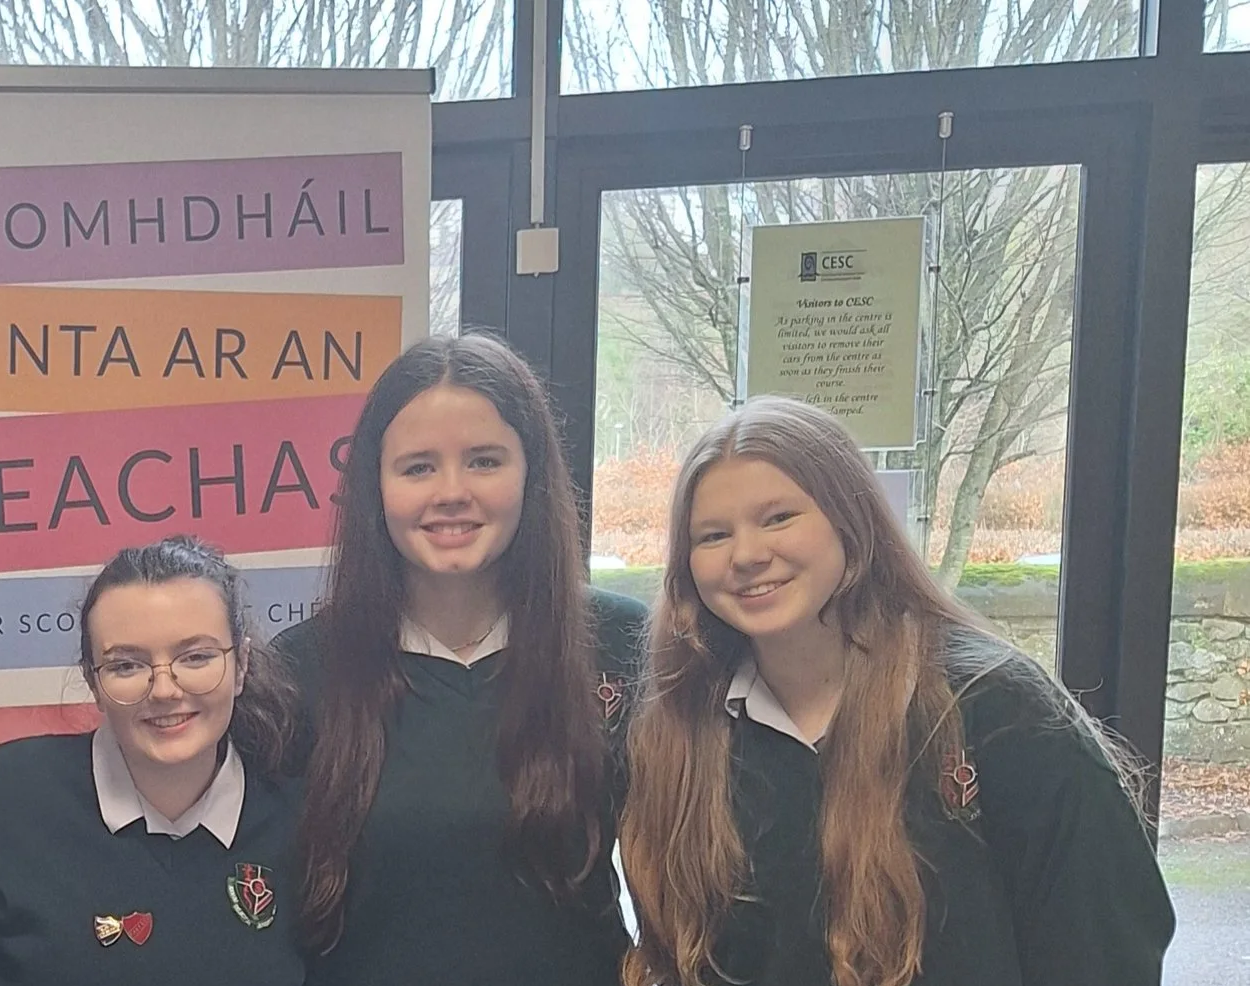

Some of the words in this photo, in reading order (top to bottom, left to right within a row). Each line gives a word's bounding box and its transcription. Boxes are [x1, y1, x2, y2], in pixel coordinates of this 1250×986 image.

[822, 255, 853, 269] CESC
[796, 299, 831, 309] Visitors
[834, 299, 844, 307] to
[845, 296, 874, 307] CESC
[774, 316, 788, 327] As
[789, 315, 825, 328] parking
[838, 312, 853, 323] the
[854, 313, 883, 322] centre
[884, 311, 892, 321] is
[830, 325, 857, 336] would
[859, 325, 877, 336] ask
[877, 323, 890, 334] all
[782, 342, 815, 351] visitors
[817, 341, 827, 349] to
[862, 338, 884, 347] their
[163, 326, 248, 379] AR
[271, 329, 363, 381] AN
[782, 356, 801, 364] cars
[801, 352, 824, 366] from
[826, 352, 841, 362] the
[842, 352, 870, 361] centre
[871, 352, 882, 360] as
[780, 368, 800, 377] soon
[801, 367, 812, 375] as
[813, 365, 834, 378] they
[832, 363, 861, 377] finish
[863, 362, 886, 373] their
[815, 379, 846, 388] course.
[823, 395, 833, 403] in
[834, 391, 850, 403] the
[850, 393, 879, 402] centre
[828, 405, 864, 417] lamped.
